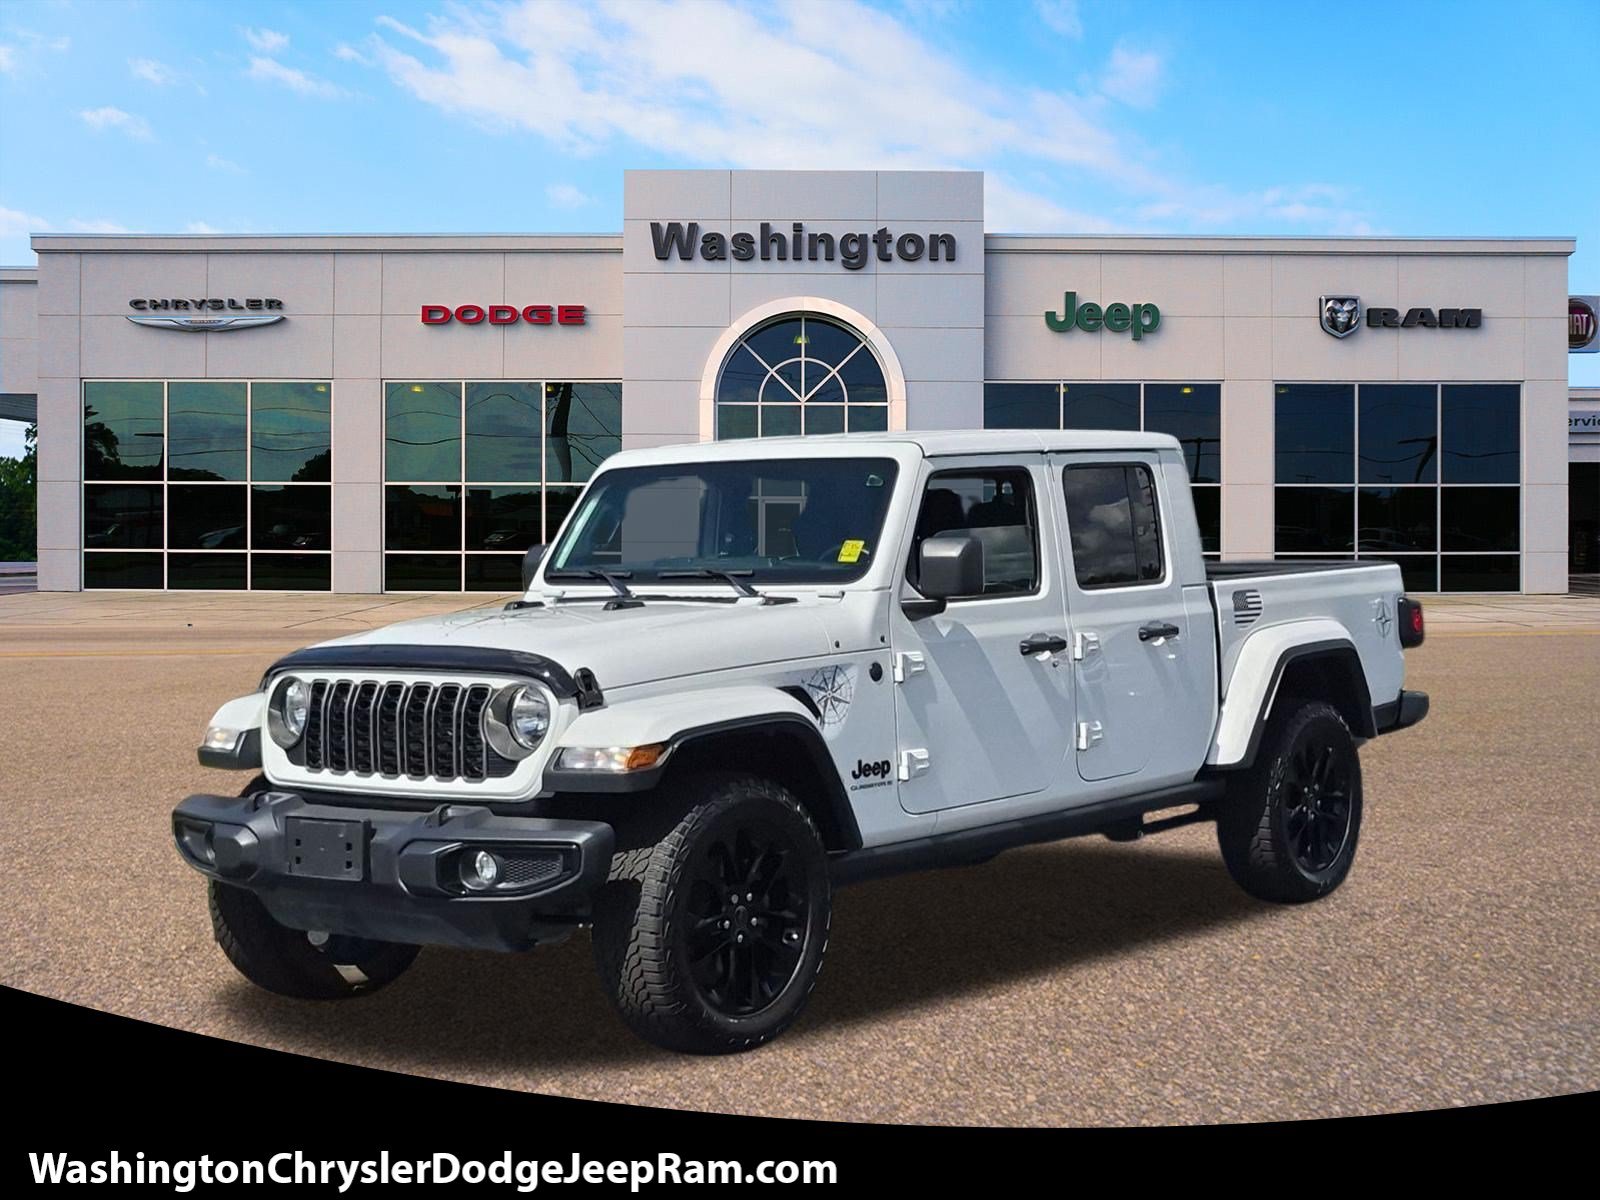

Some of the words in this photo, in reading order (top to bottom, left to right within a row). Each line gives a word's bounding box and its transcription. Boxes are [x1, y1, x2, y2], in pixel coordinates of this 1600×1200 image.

[650, 222, 957, 271] Washington
[129, 298, 285, 311] CHRYSLER
[421, 304, 587, 325] DODGE
[1045, 291, 1161, 341] Jeep
[1366, 307, 1482, 330] RAM
[1568, 313, 1589, 336] IAT
[851, 759, 891, 780] Jeep
